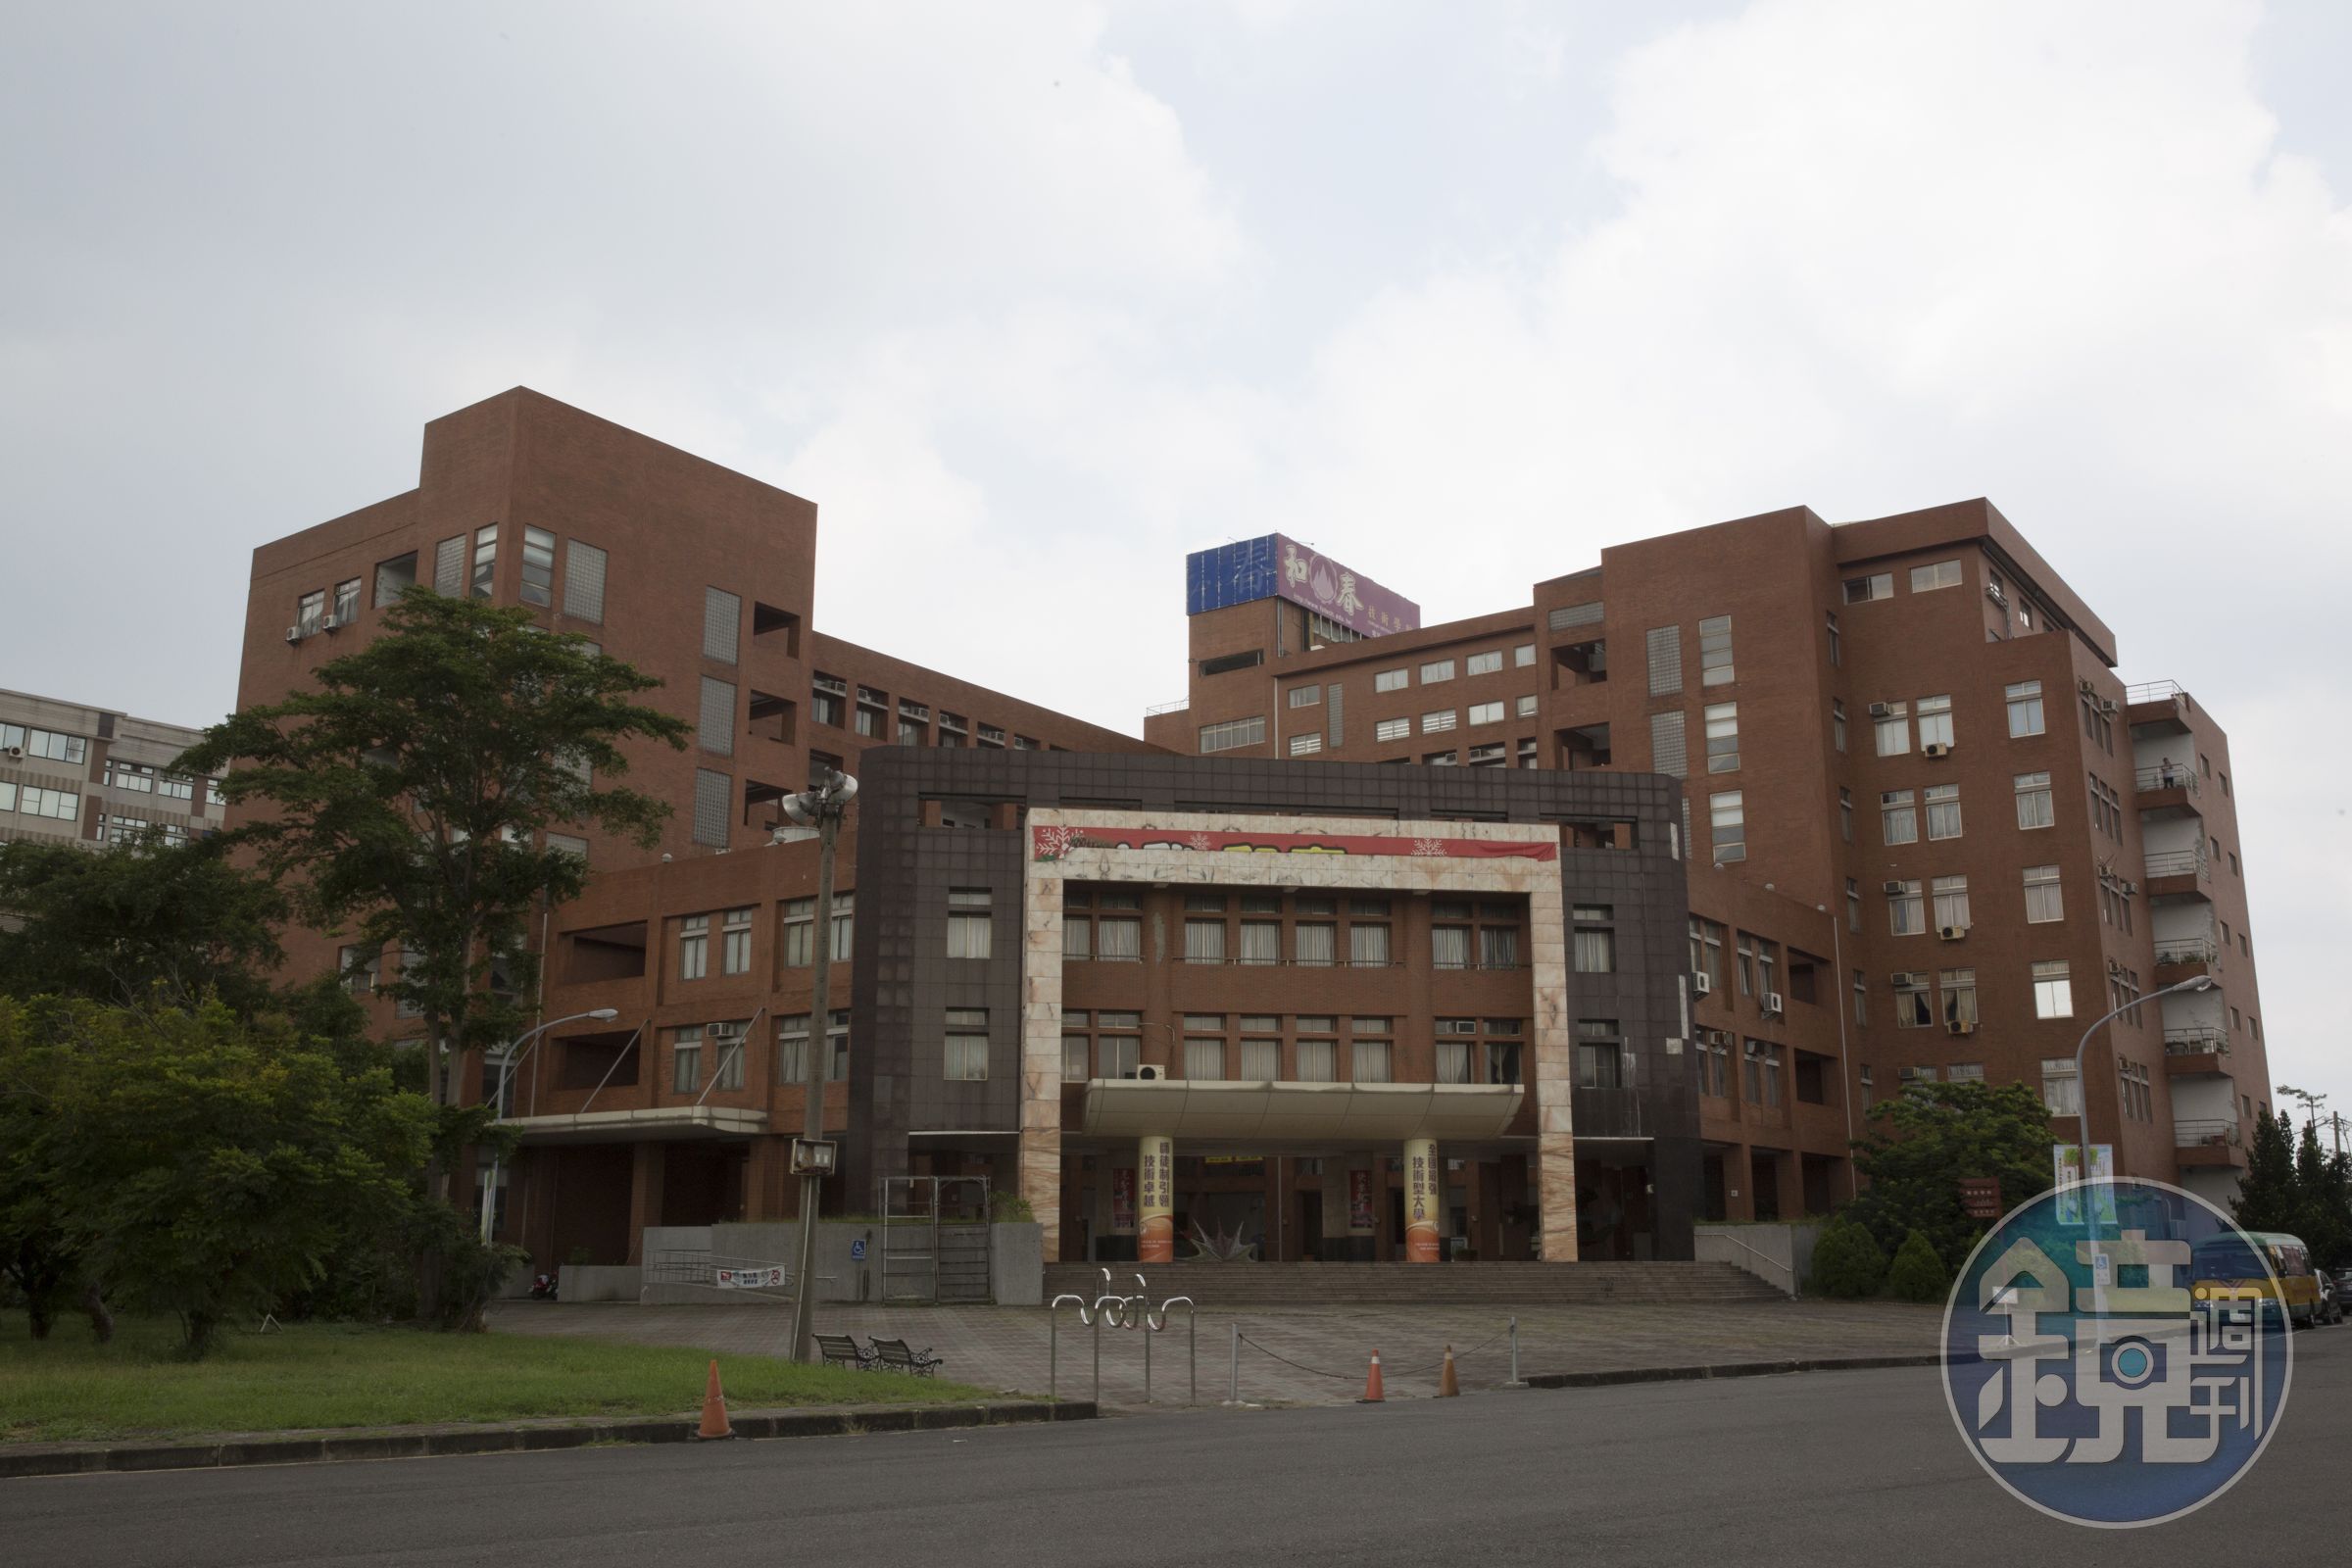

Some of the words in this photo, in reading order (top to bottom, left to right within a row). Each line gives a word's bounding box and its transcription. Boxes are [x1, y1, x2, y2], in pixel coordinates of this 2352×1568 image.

[1284, 544, 1308, 588] 和
[1337, 571, 1365, 616] 春
[1412, 1156, 1425, 1219] 技術型大學
